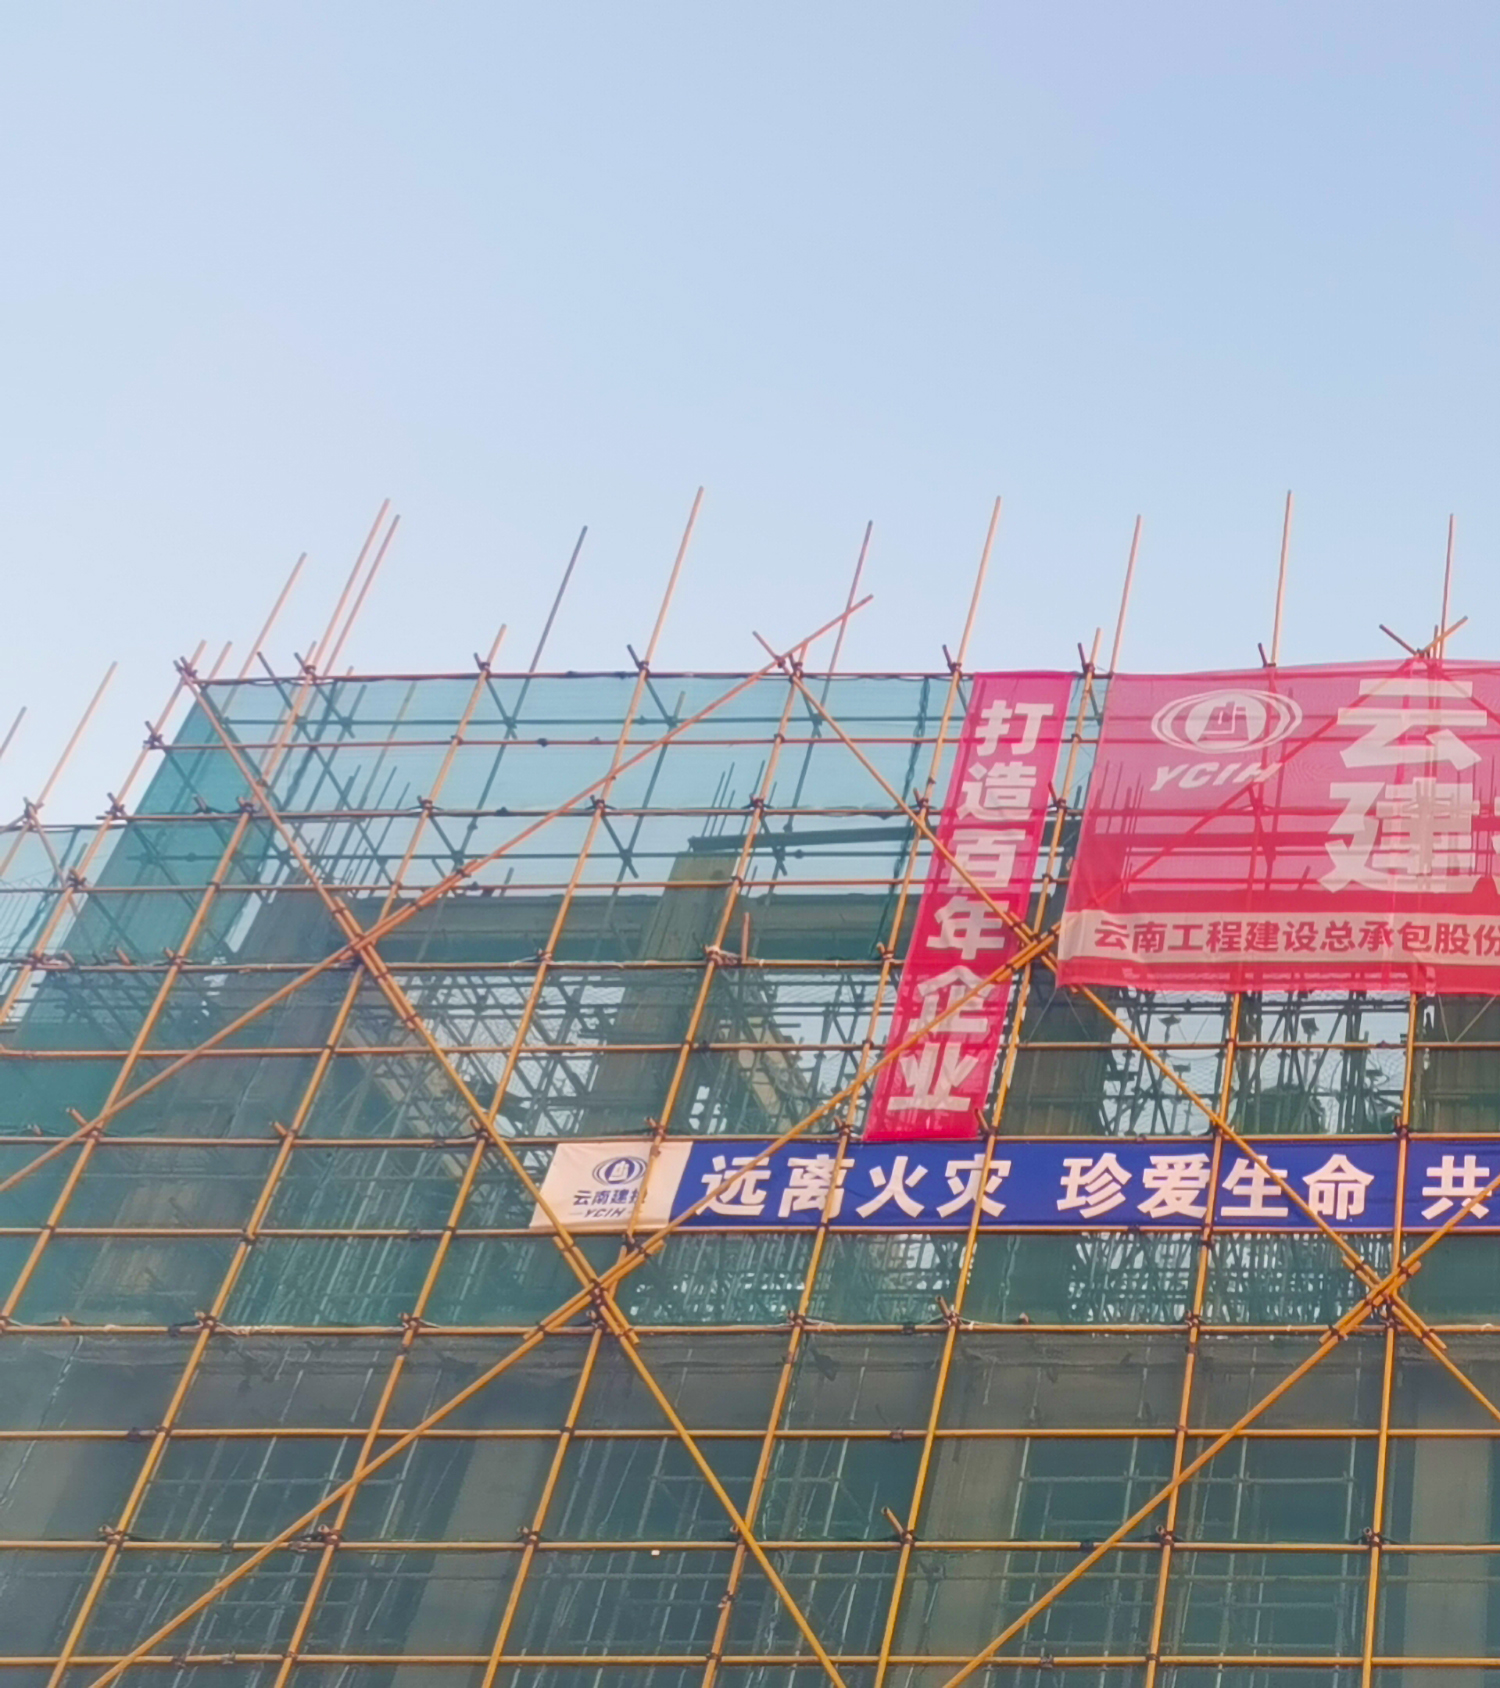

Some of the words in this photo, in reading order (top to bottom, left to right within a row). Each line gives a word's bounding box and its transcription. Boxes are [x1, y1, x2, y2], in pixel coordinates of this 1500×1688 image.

[1150, 761, 1283, 792] YCIH
[888, 699, 1054, 1113] 打造百年企业
[695, 1153, 1012, 1219] 远离火灾
[1056, 1152, 1376, 1220] 珍爱生命
